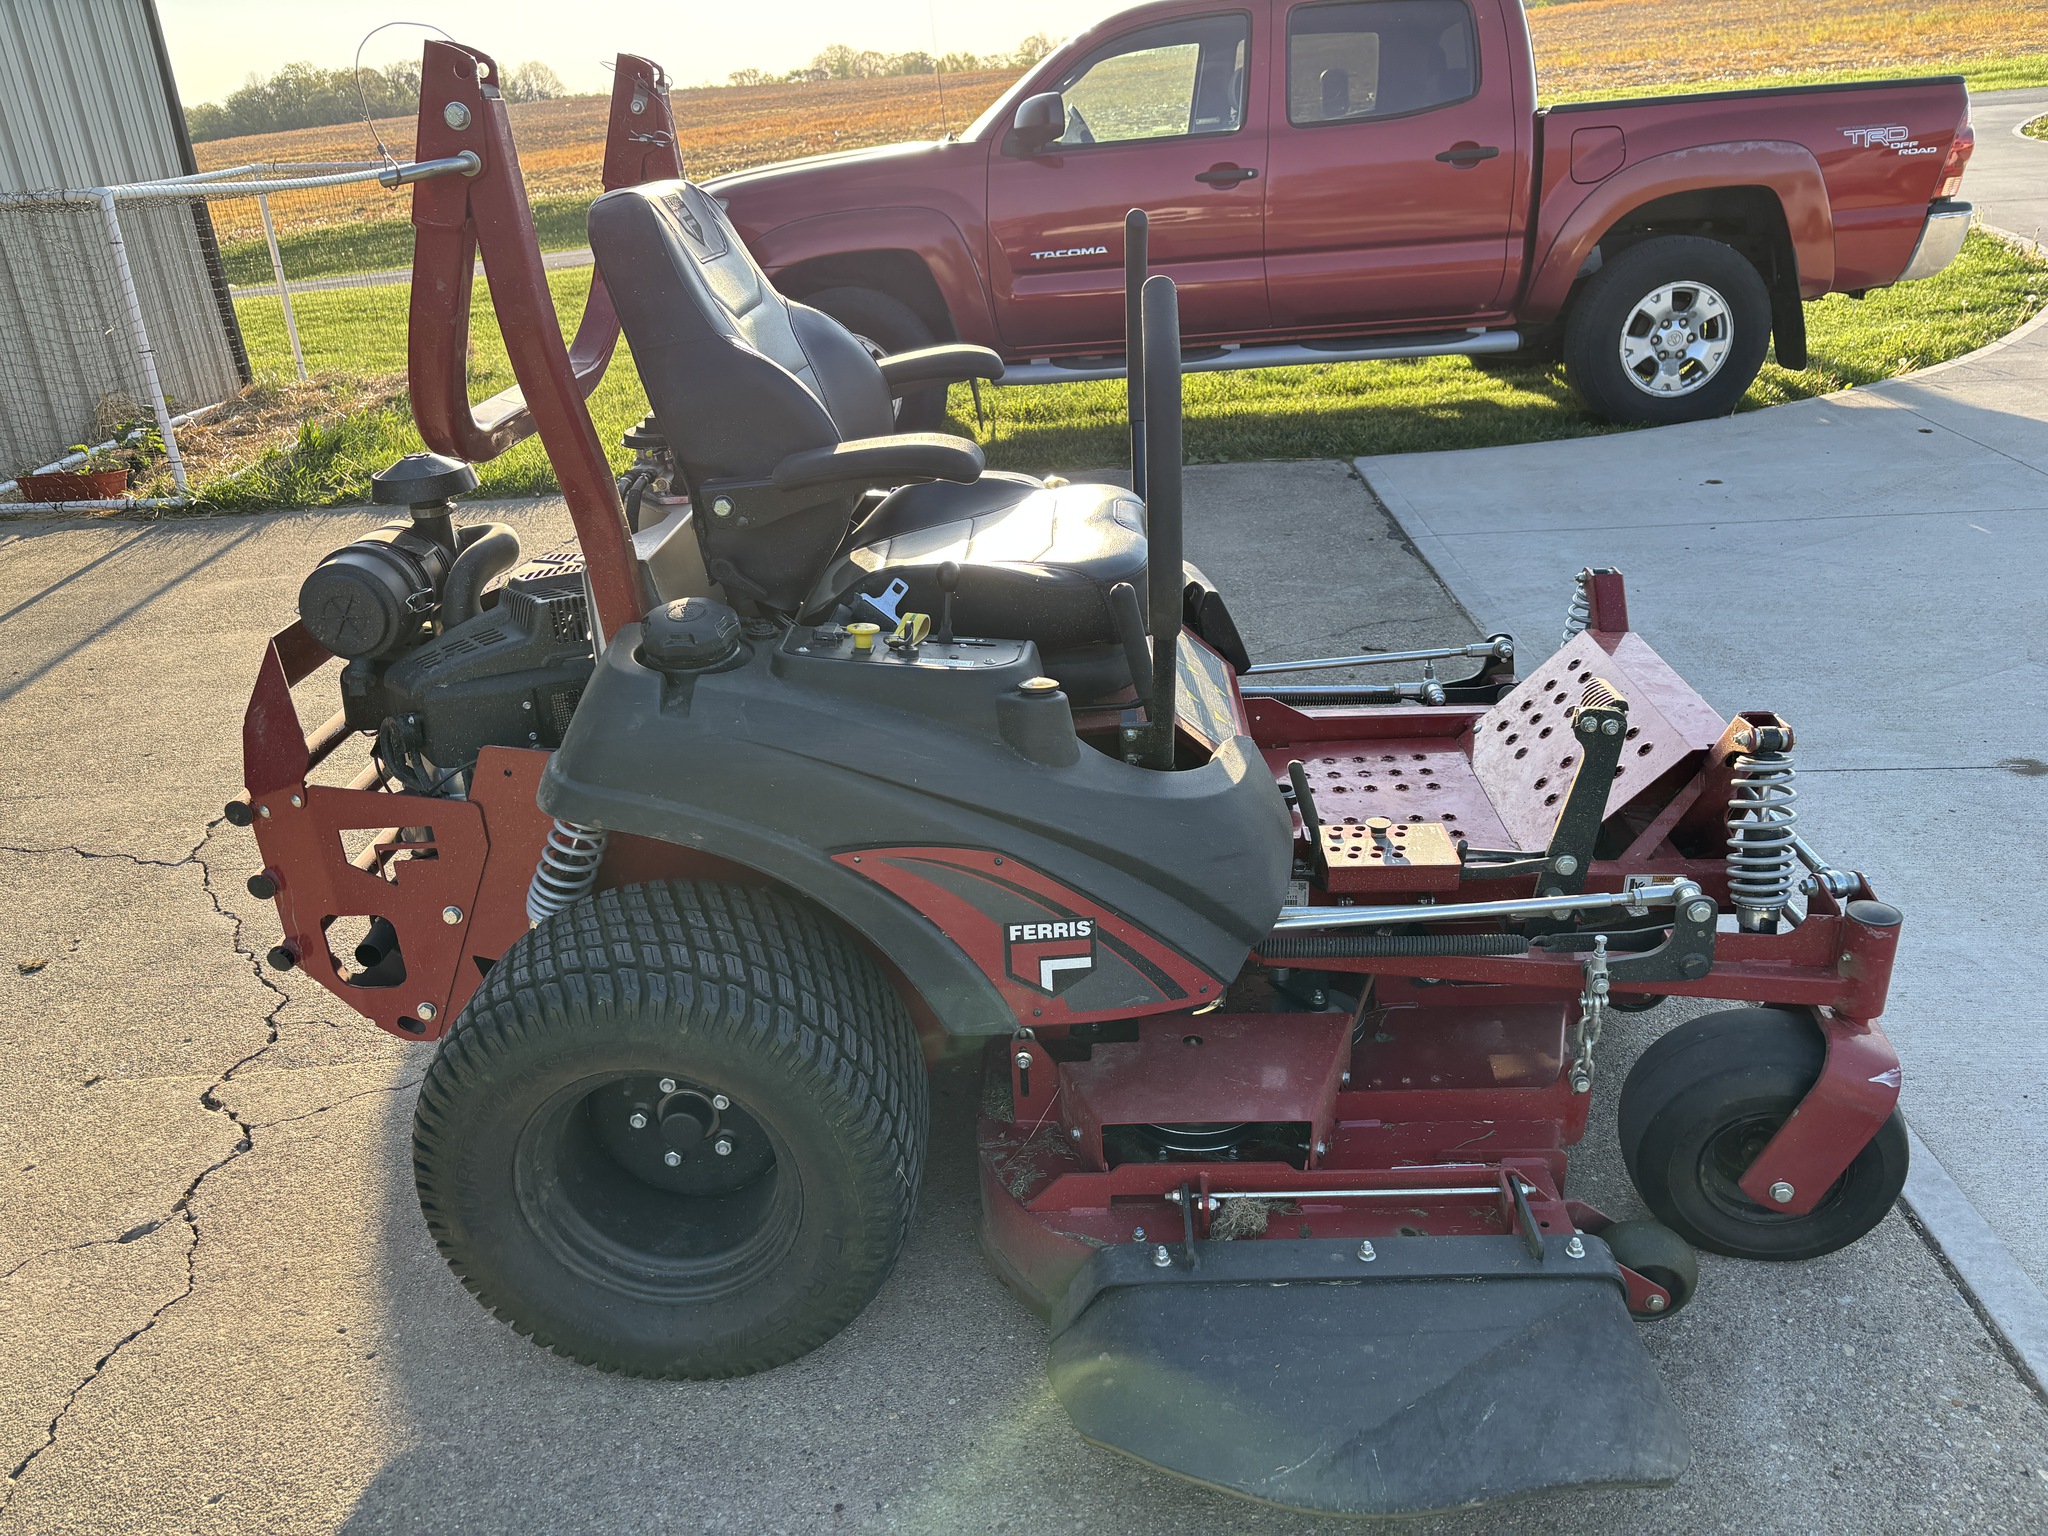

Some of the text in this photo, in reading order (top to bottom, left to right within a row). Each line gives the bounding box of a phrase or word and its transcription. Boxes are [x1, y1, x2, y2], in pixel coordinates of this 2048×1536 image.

[1844, 126, 1908, 148] TRD
[1890, 141, 1919, 149] OFF
[1898, 147, 1937, 156] ROAD
[1030, 246, 1108, 260] TACOMA
[1009, 920, 1092, 942] FERRIS
